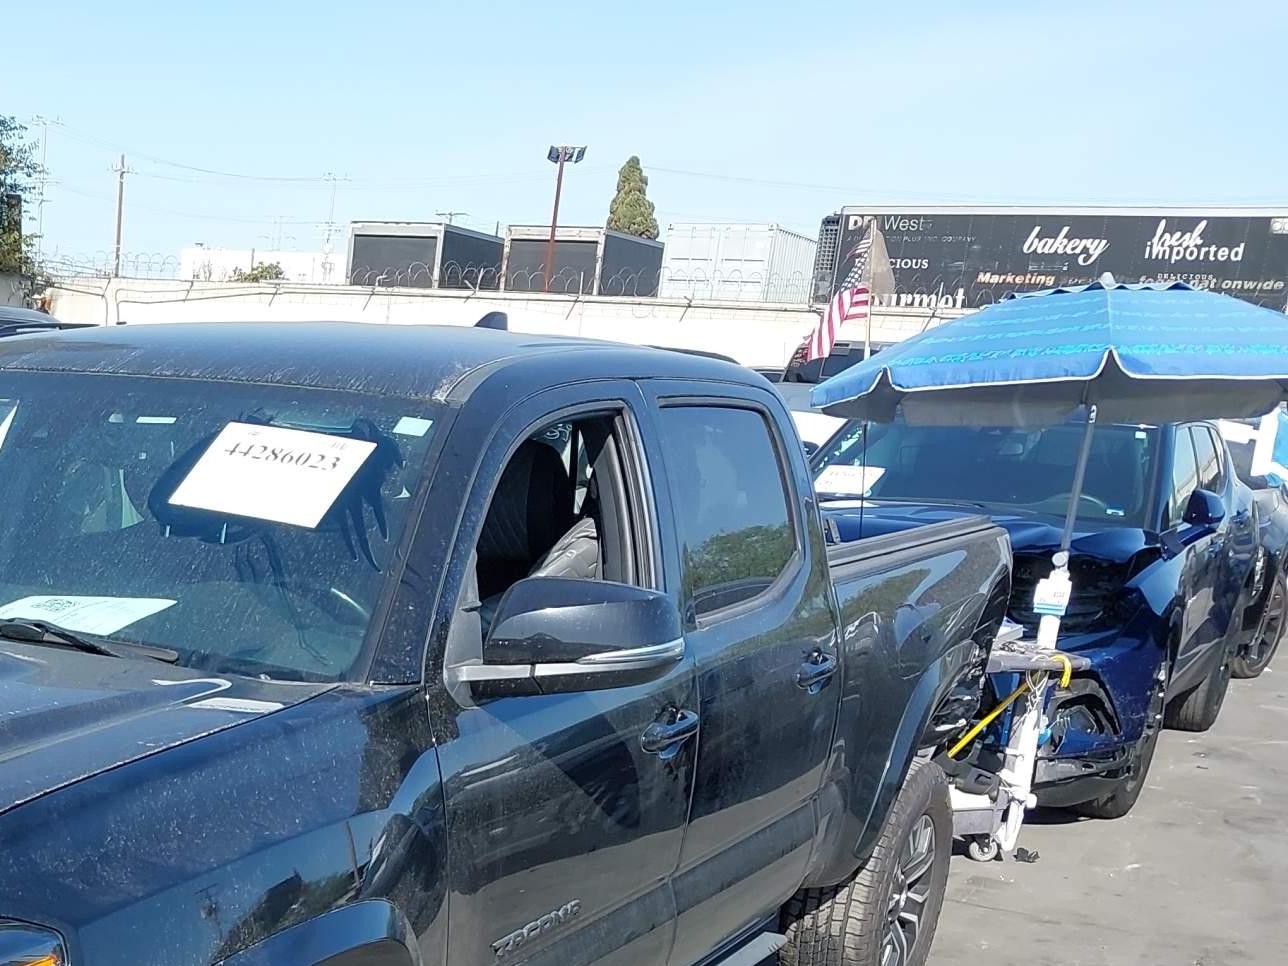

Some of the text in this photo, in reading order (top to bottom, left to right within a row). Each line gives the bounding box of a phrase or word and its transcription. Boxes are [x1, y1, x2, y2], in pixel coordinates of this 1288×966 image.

[883, 215, 927, 231] West
[1023, 226, 1110, 266] bakery
[1144, 241, 1245, 264] imported
[976, 271, 1056, 287] Marketing
[1189, 276, 1285, 291] natonwide
[872, 287, 966, 308] urmet
[224, 442, 341, 471] 44286023
